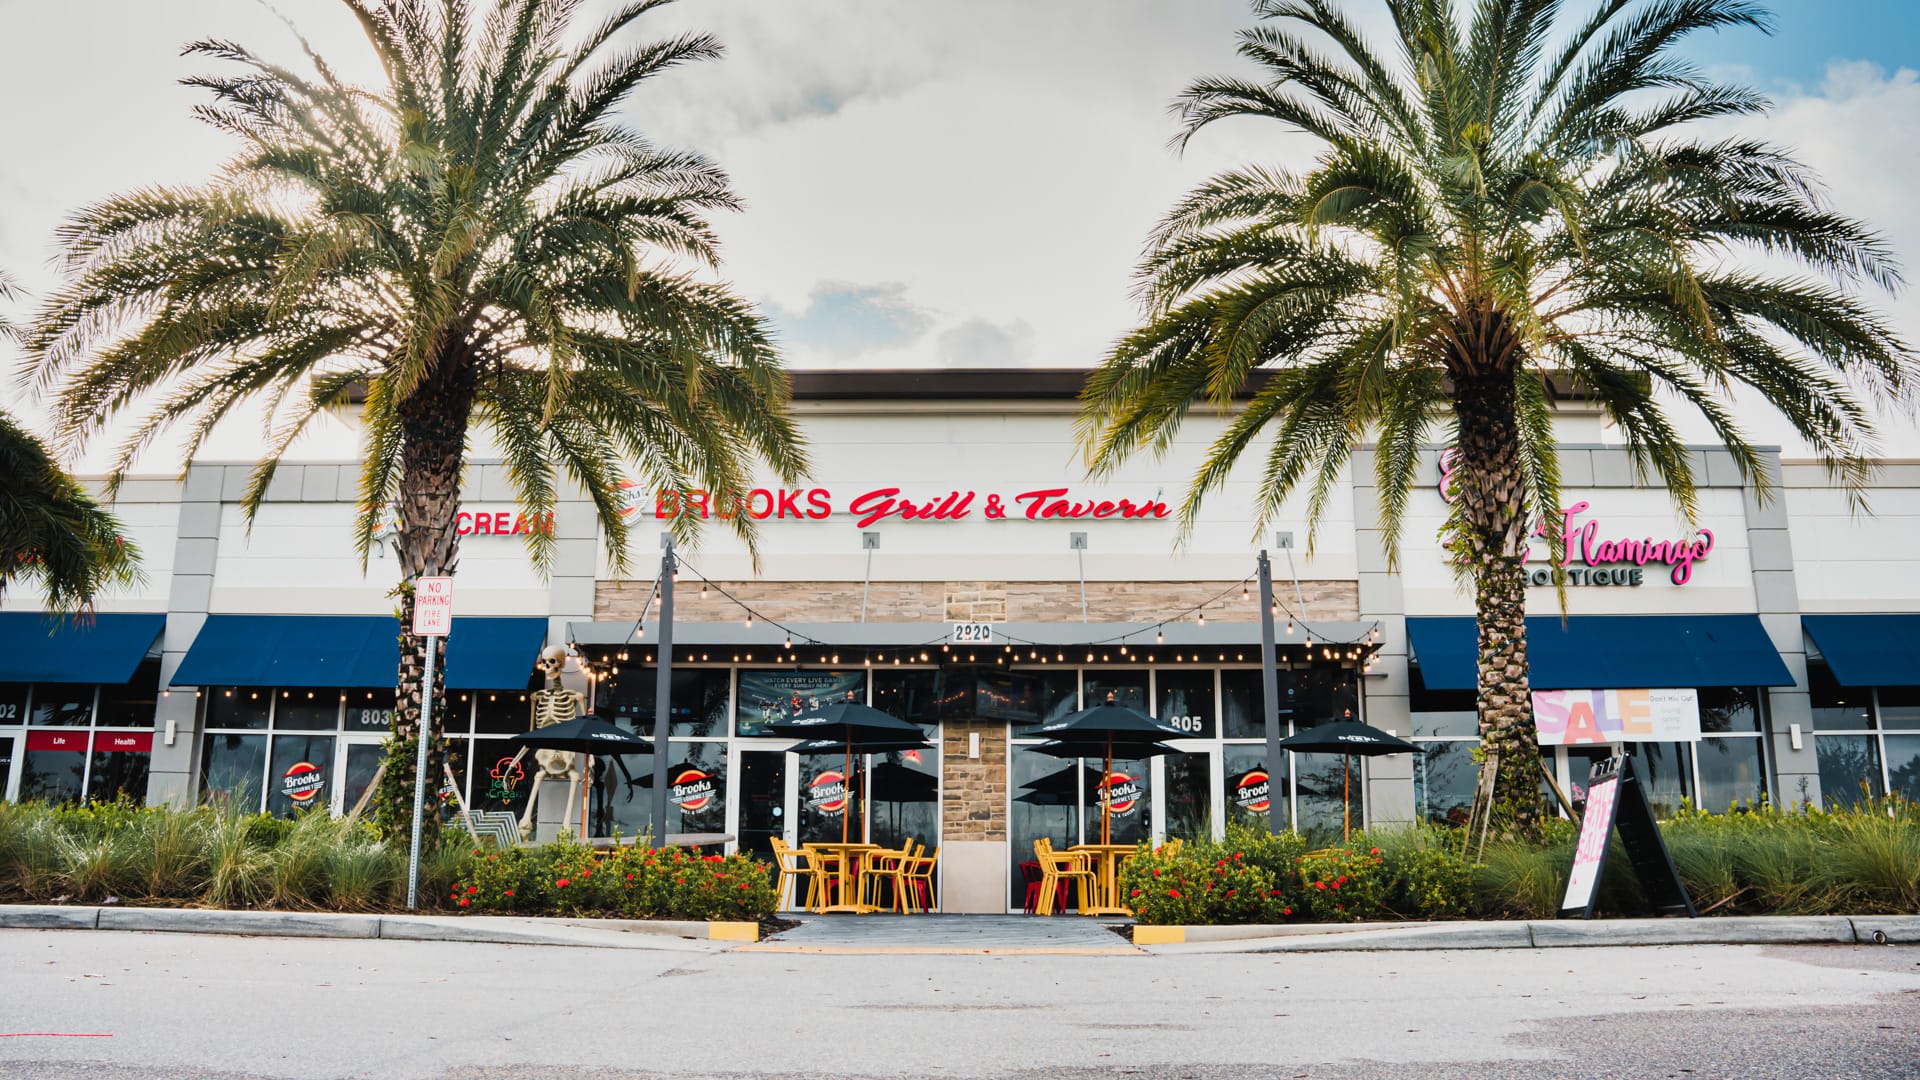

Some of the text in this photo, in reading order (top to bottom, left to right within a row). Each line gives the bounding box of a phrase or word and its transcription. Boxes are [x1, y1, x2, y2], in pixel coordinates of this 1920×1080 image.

[656, 488, 831, 519] BROOKS
[849, 488, 976, 528] Grill
[984, 494, 1006, 519] &
[1015, 488, 1172, 520] Tavern
[455, 512, 554, 536] CREAM
[1556, 502, 1714, 585] Flamingo
[427, 582, 442, 593] NO
[418, 595, 449, 606] PARKING
[424, 610, 441, 618] FIRE
[424, 619, 440, 627] LANE
[361, 709, 390, 725] 803
[1171, 716, 1202, 732] 805
[1534, 689, 1653, 745] SALE
[53, 737, 66, 745] Life
[114, 738, 136, 746] Health
[284, 772, 320, 789] Brooks
[673, 780, 711, 797] Brooks
[1238, 782, 1270, 799] Brook
